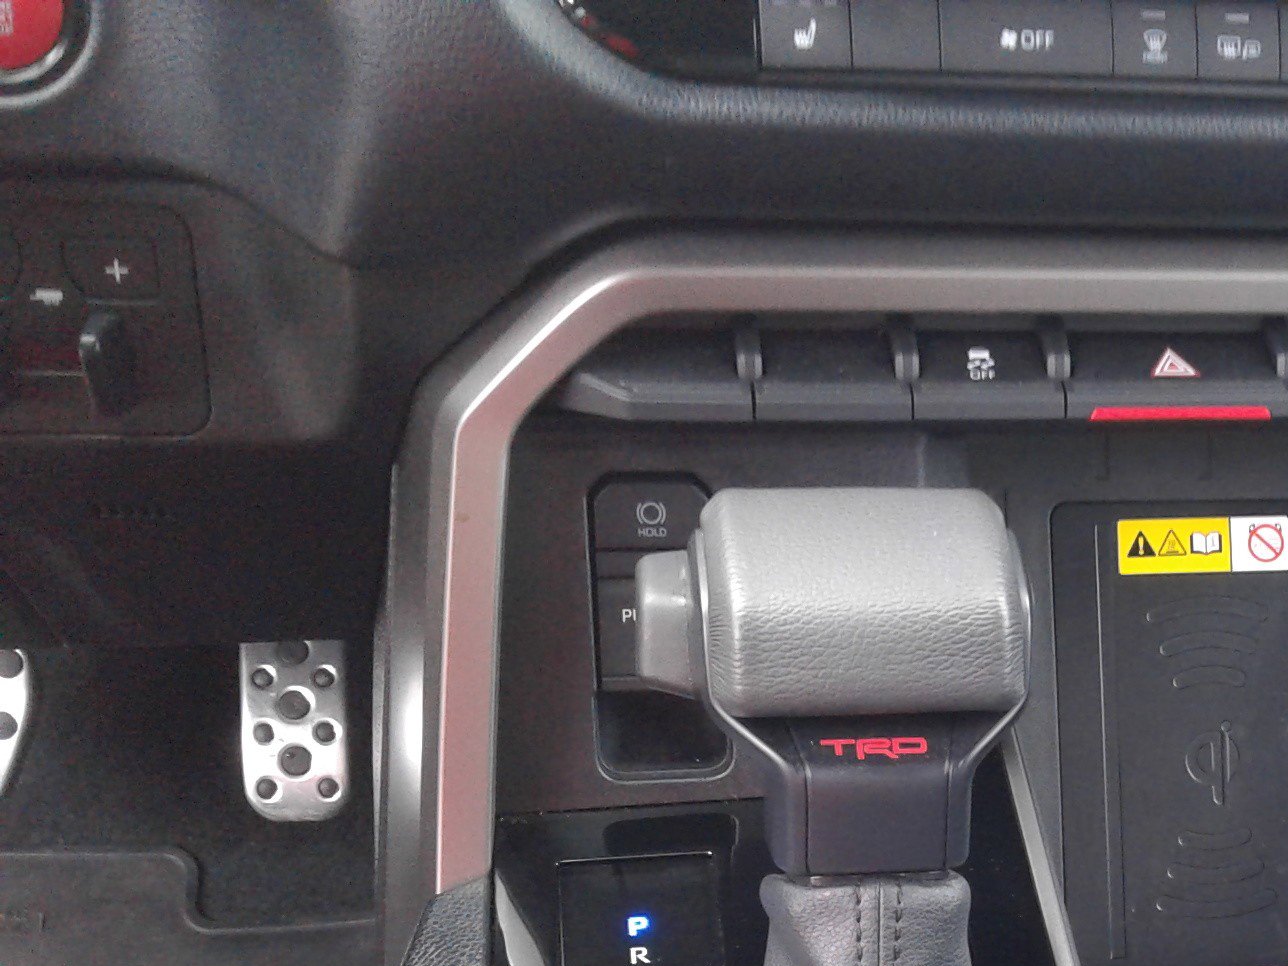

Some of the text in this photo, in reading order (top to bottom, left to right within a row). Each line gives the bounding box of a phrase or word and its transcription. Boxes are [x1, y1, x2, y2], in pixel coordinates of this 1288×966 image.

[1020, 29, 1054, 51] OFF
[637, 527, 667, 538] HOLD
[820, 737, 927, 760] TRD
[627, 916, 649, 937] P
[630, 946, 651, 965] R
